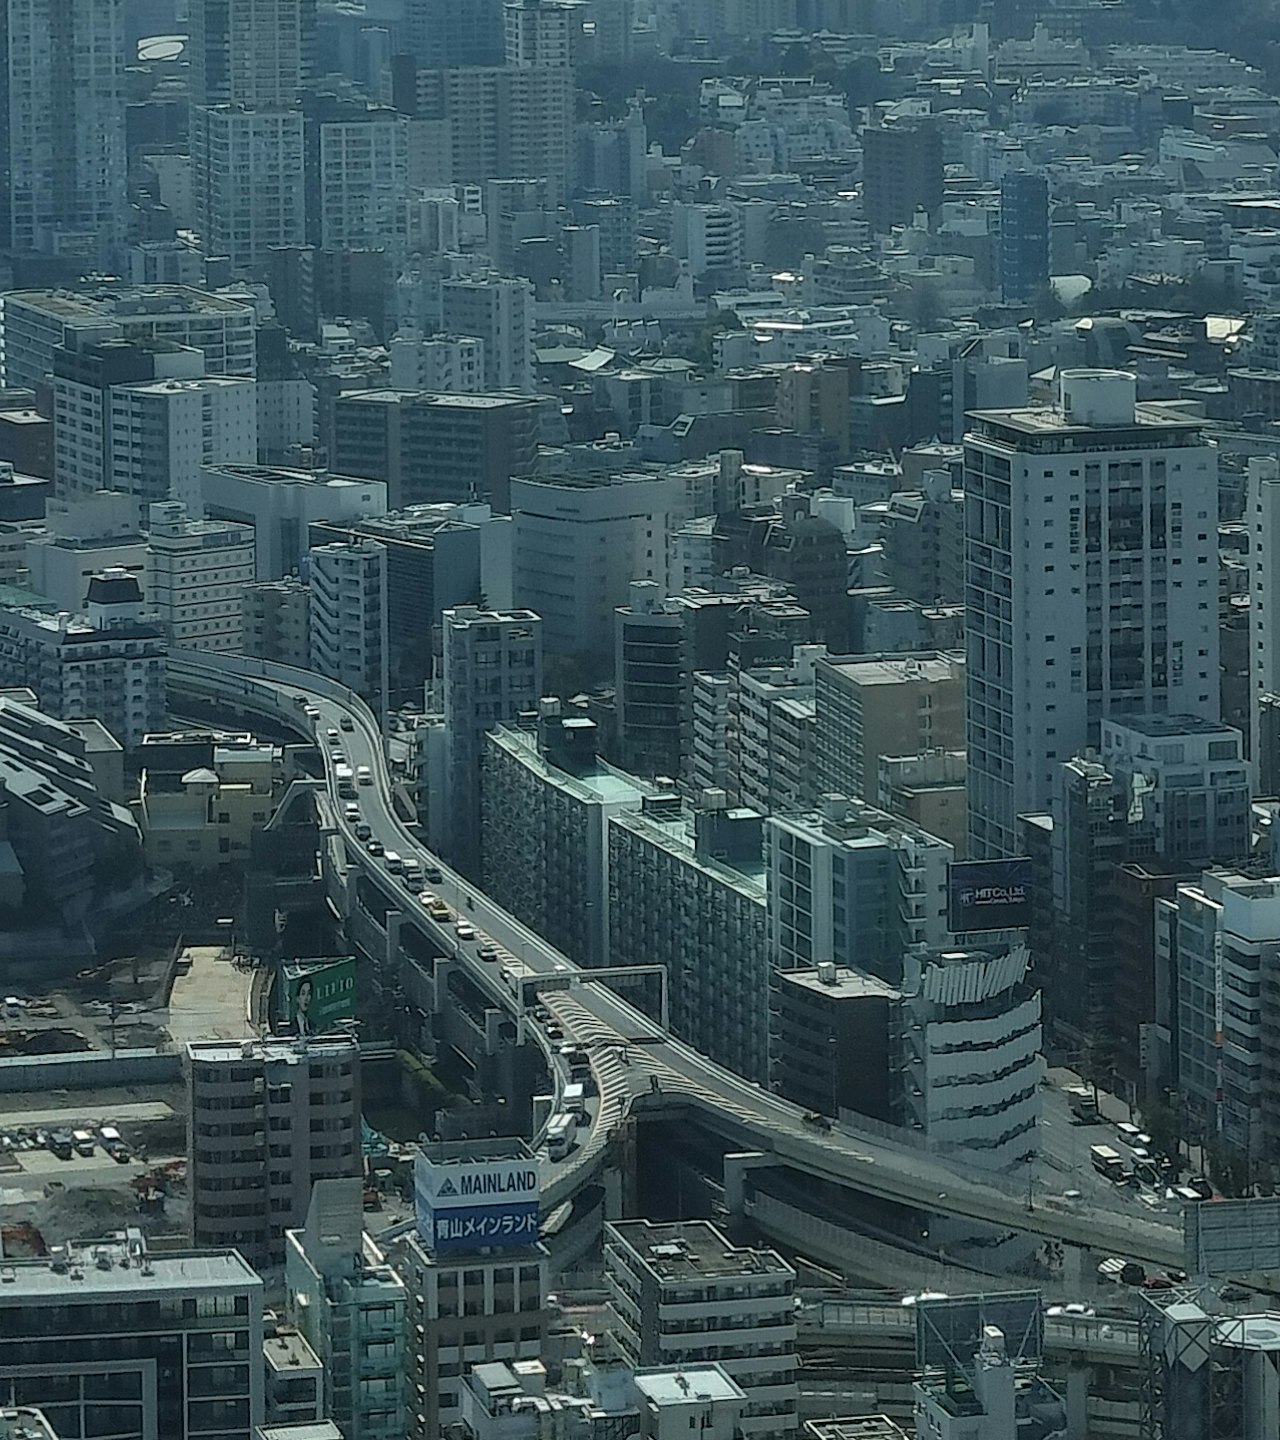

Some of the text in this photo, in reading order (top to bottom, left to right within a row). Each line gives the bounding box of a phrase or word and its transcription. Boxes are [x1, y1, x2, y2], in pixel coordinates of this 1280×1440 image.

[461, 1171, 536, 1195] MAINLAND
[437, 1212, 537, 1240] 青山メインランド
